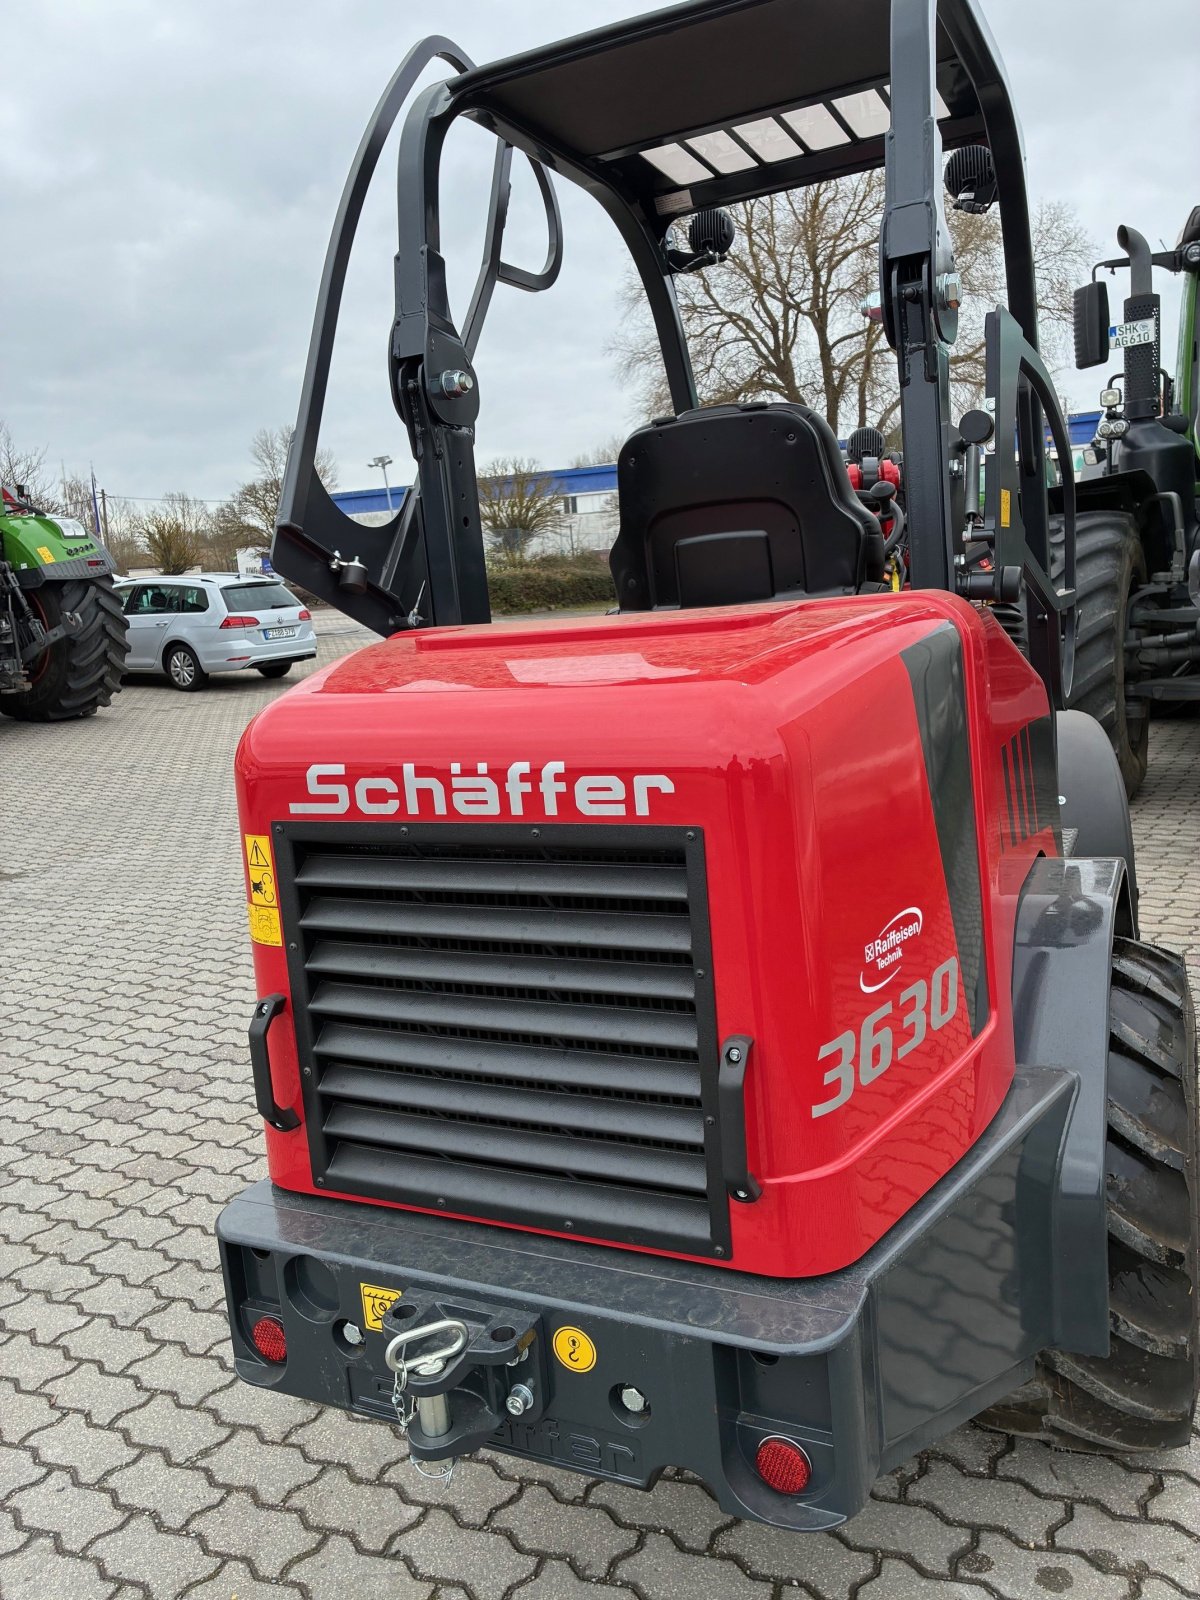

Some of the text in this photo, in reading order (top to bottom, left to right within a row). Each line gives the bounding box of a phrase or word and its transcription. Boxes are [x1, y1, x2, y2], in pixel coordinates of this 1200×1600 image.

[1118, 324, 1139, 336] SHK
[289, 761, 675, 815] Schäffer
[874, 921, 919, 957] Raiffeisen
[875, 946, 903, 971] Technik
[811, 955, 959, 1119] 3630
